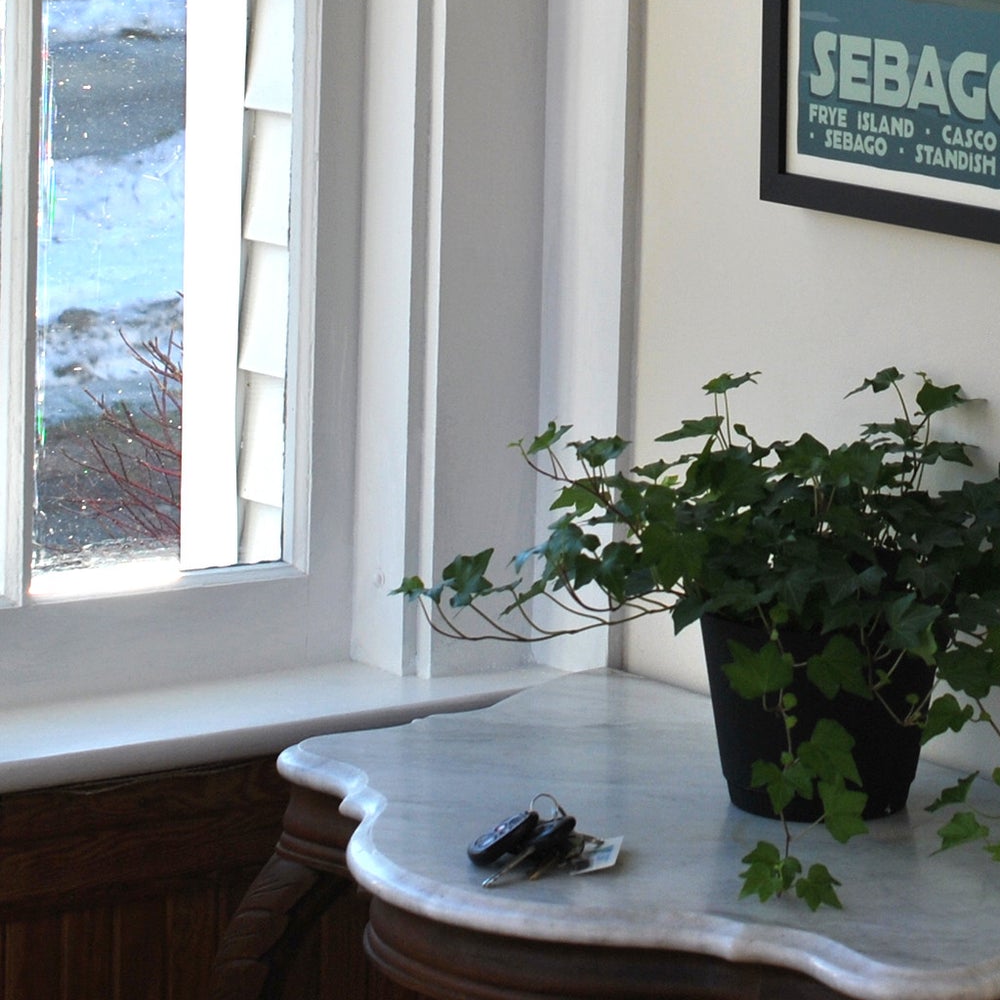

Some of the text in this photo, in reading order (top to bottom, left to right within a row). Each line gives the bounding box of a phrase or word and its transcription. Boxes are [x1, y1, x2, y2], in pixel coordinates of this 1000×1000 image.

[808, 103, 848, 128] FRYE
[941, 124, 997, 152] CASCO
[824, 128, 888, 157] SEBAGO
